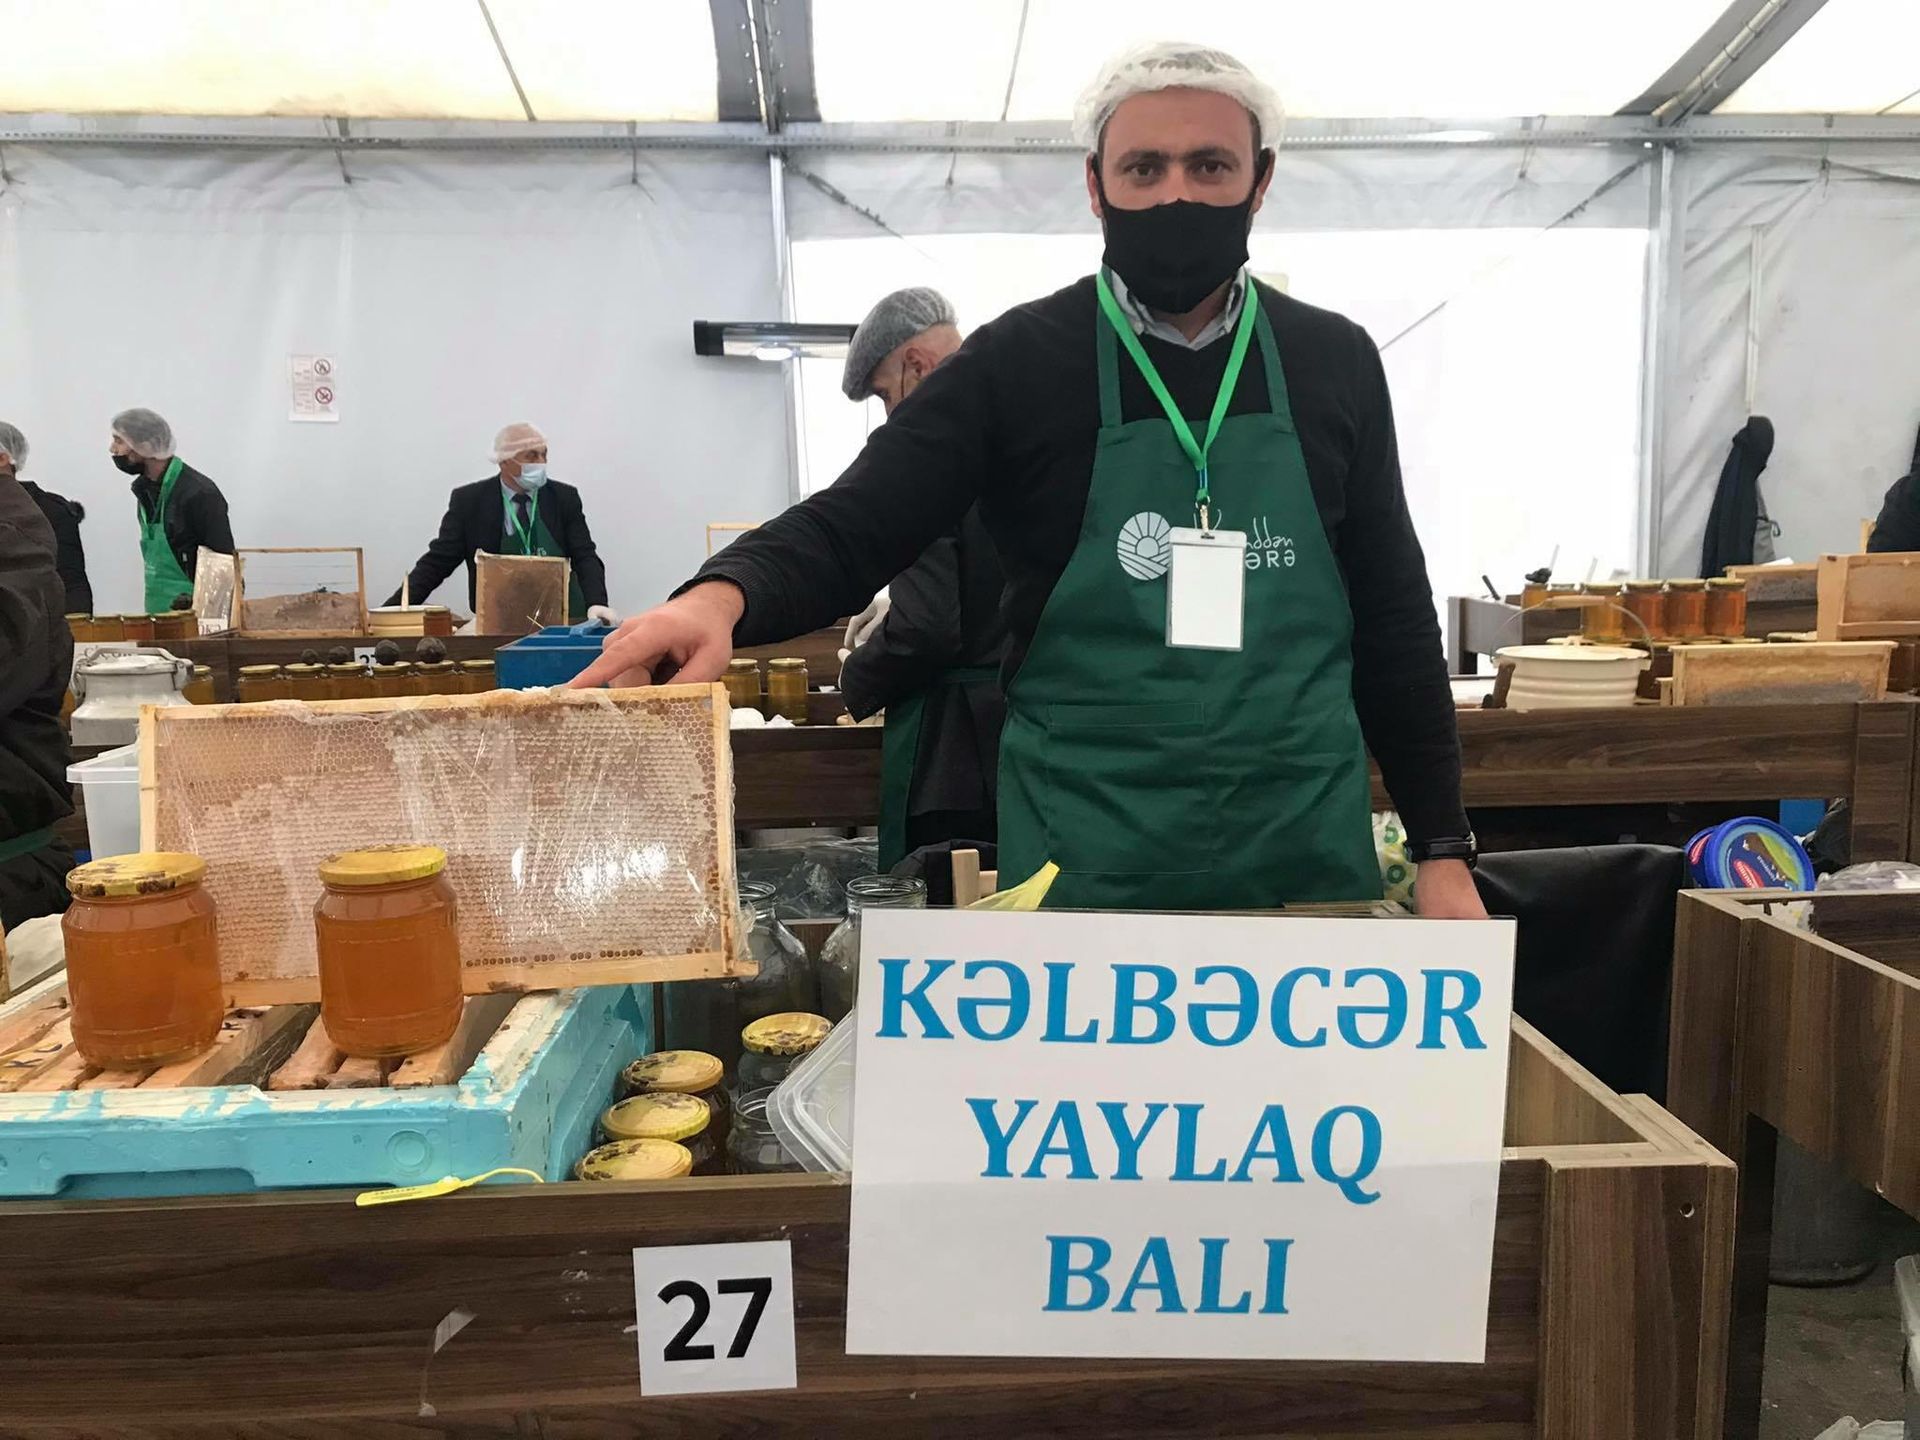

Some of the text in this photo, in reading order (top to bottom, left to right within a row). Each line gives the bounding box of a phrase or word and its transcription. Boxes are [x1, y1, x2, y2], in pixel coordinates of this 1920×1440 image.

[876, 958, 1487, 1049] KƏLBƏCƏR
[966, 1098, 1384, 1205] YAYLAQ
[656, 1276, 774, 1362] 27
[1042, 1235, 1293, 1315] BALI
